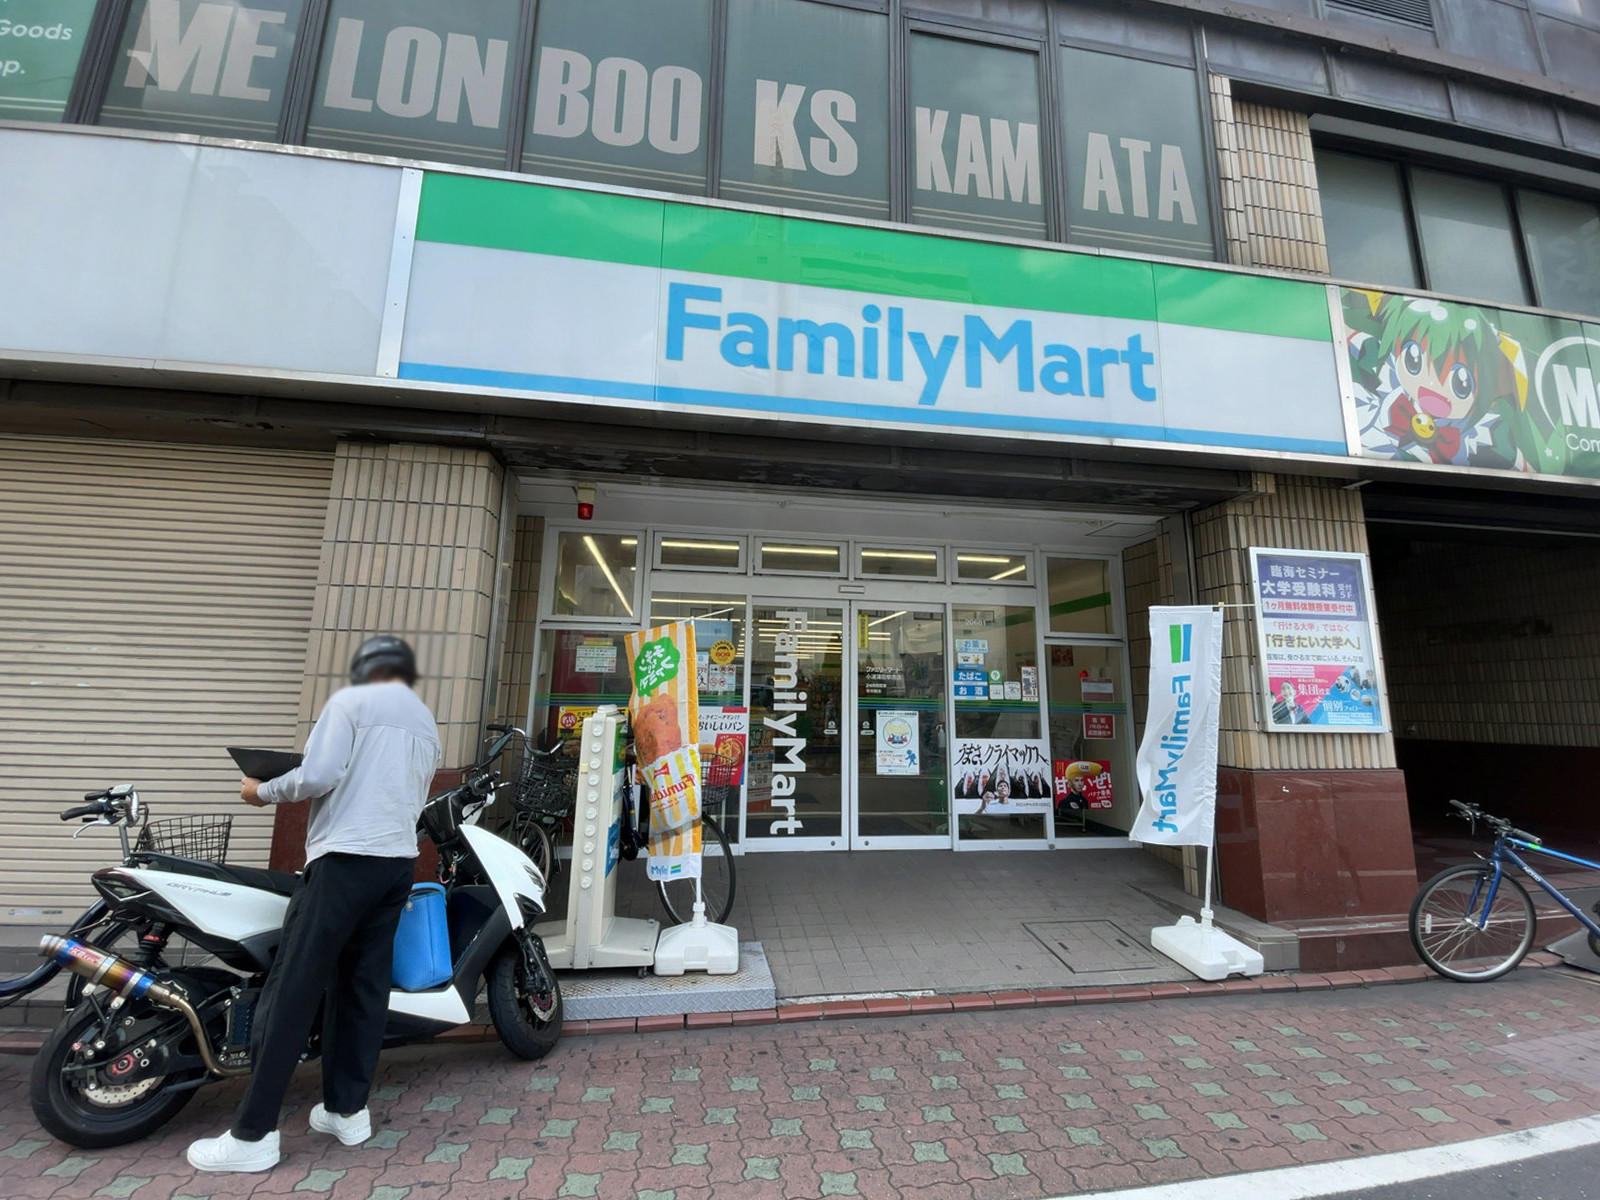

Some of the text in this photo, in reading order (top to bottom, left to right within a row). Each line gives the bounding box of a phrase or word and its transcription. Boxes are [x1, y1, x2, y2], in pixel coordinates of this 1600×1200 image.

[0, 19, 72, 41] Goods
[665, 282, 1158, 406] FamilyMart
[1270, 564, 1340, 580] 臨海セミナー
[1261, 580, 1336, 598] 大学受験科
[1265, 634, 1361, 650] 「行きたい大学へ」
[958, 672, 982, 681] たばこ
[763, 610, 808, 835] FamilyMart
